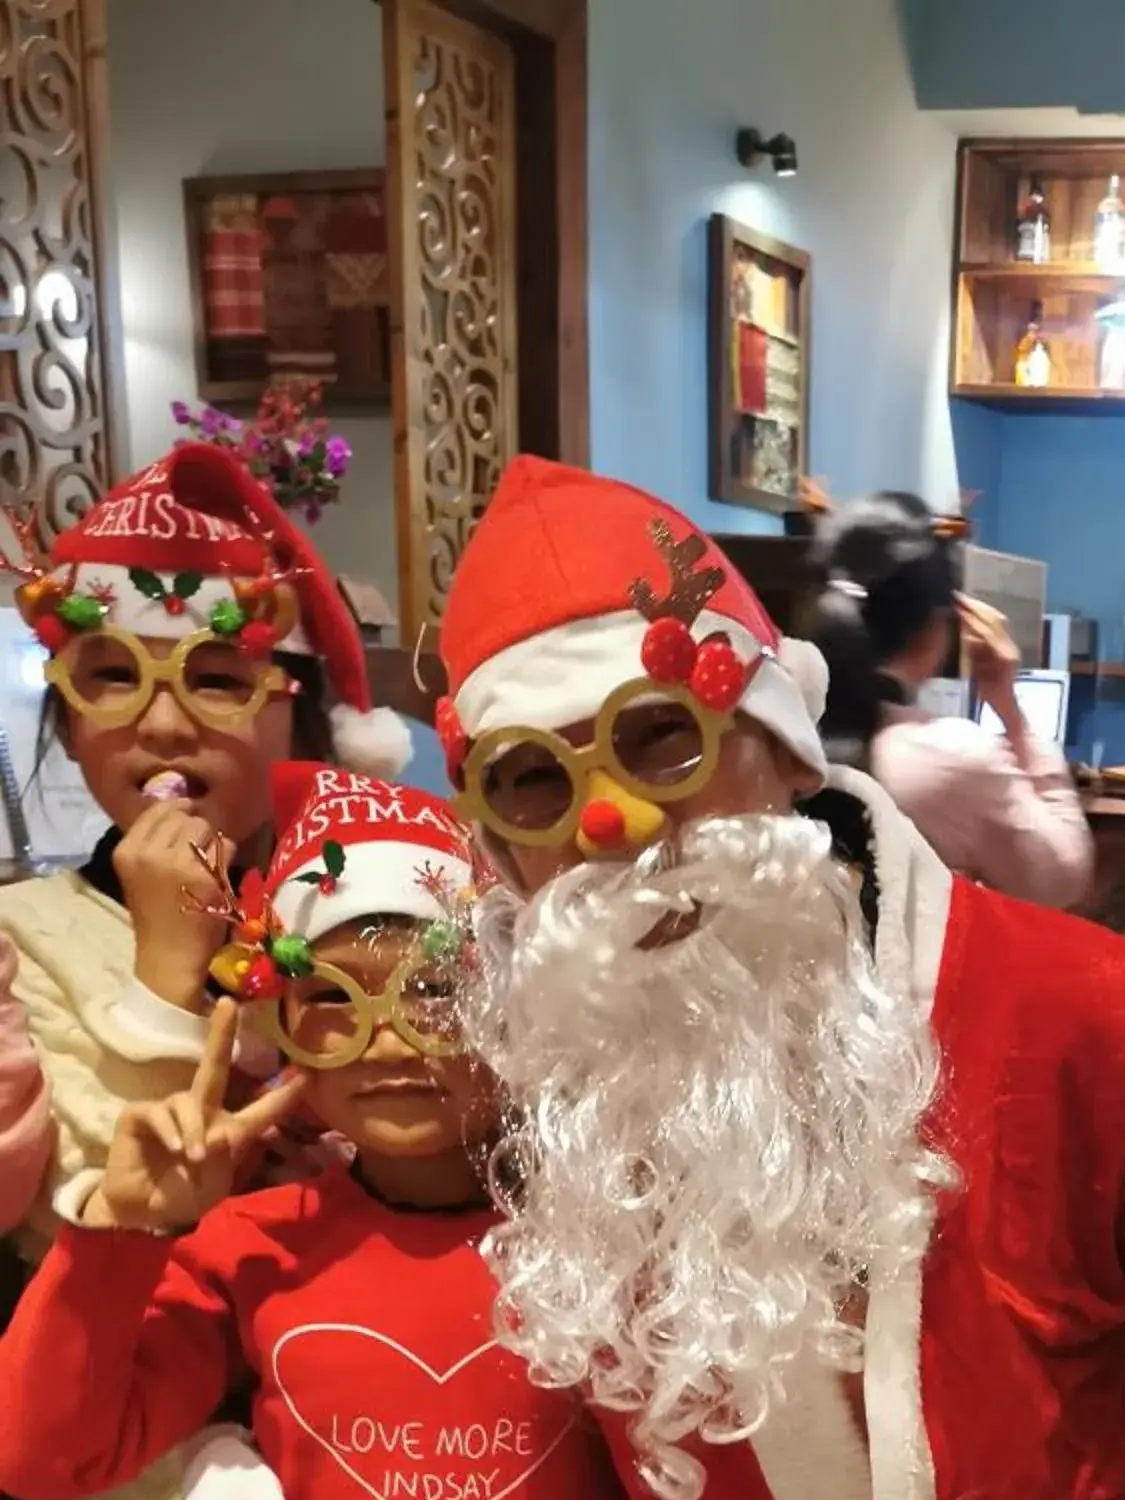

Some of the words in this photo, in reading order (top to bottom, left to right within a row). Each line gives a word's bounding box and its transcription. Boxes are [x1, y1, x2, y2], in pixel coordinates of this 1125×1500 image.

[310, 769, 404, 800] RRY
[332, 1414, 425, 1459] LOVE
[436, 1418, 533, 1459] MORE
